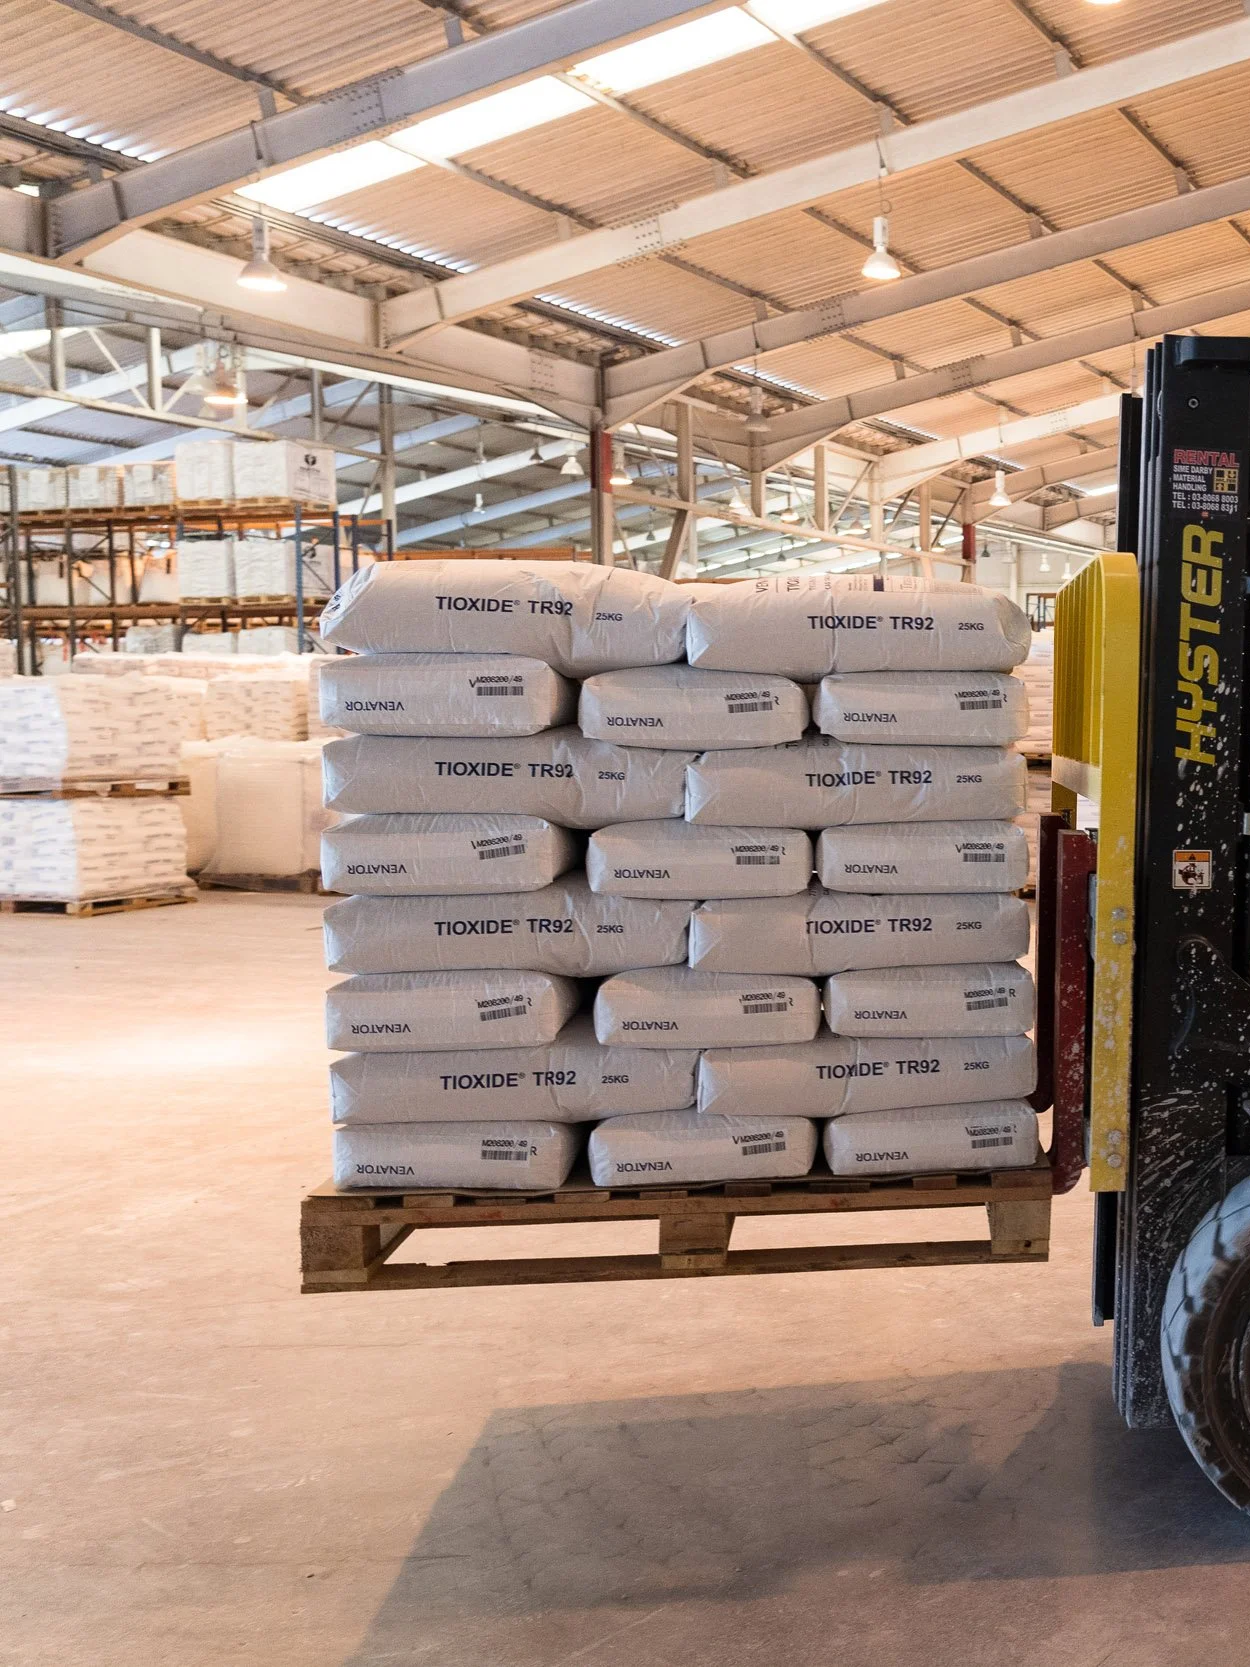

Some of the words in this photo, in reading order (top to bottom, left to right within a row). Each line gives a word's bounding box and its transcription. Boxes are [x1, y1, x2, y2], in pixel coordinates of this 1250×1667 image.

[1173, 449, 1240, 468] RENTAL
[1173, 465, 1190, 473] SIME
[1191, 466, 1213, 474] DARBY
[1173, 474, 1206, 483] MATERIAL
[1173, 482, 1207, 491] HANDLING
[1172, 492, 1186, 500] TEL
[1191, 493, 1220, 502] 03-8068
[1221, 495, 1239, 503] 8003
[1172, 501, 1186, 509] TEL
[1191, 502, 1220, 511] 03-8068
[529, 600, 574, 617] TR92
[595, 612, 623, 622] 25KG
[889, 616, 935, 631] TR92
[957, 621, 985, 631] 25KG
[1175, 523, 1224, 765] HYSTER
[344, 700, 405, 712] VENATOR
[606, 715, 664, 728] VENATOR
[843, 712, 898, 723] VENATOR
[528, 763, 574, 778] TR92
[597, 770, 626, 781] 25KG
[888, 770, 933, 785] TR92
[955, 774, 983, 784] 25KG
[346, 863, 408, 875] VENATOR
[613, 868, 671, 880] VENATOR
[844, 862, 898, 874] VENATOR
[526, 918, 574, 934] TR92
[596, 923, 624, 934] 25KG
[887, 917, 933, 933] TR92
[955, 920, 983, 931] 25KG
[853, 1009, 908, 1020] VENATOR
[350, 1022, 412, 1034] VENATOR
[621, 1019, 679, 1031] VENATOR
[895, 1059, 941, 1075] TR92
[963, 1061, 990, 1071] 25KG
[532, 1070, 577, 1087] TR92
[601, 1074, 630, 1084] 25KG
[855, 1151, 909, 1163] VENATOR
[356, 1163, 415, 1176] VENATOR
[616, 1160, 673, 1172] VENATOR
